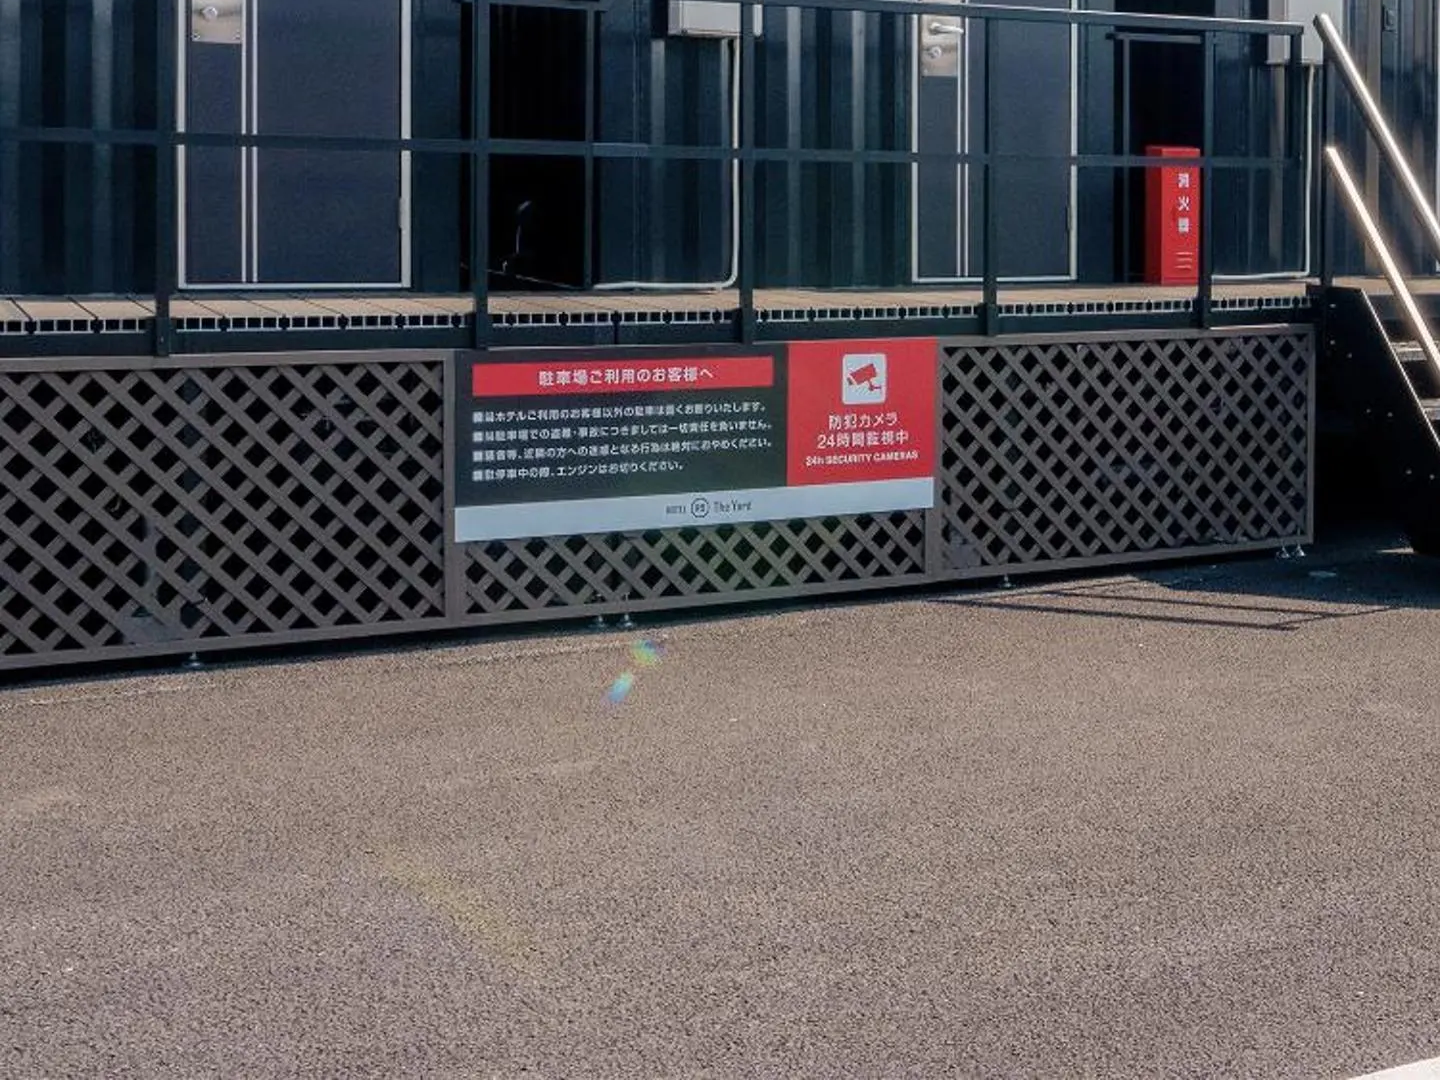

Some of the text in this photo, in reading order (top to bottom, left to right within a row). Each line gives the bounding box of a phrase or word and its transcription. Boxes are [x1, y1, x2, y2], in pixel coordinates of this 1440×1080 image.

[538, 366, 715, 387] 駐車場ご利用のお客様へ
[828, 411, 899, 430] 防犯カメラ
[816, 428, 910, 450] 24時間監視中
[825, 453, 873, 466] SECURITY
[873, 449, 919, 463] CAMERAS
